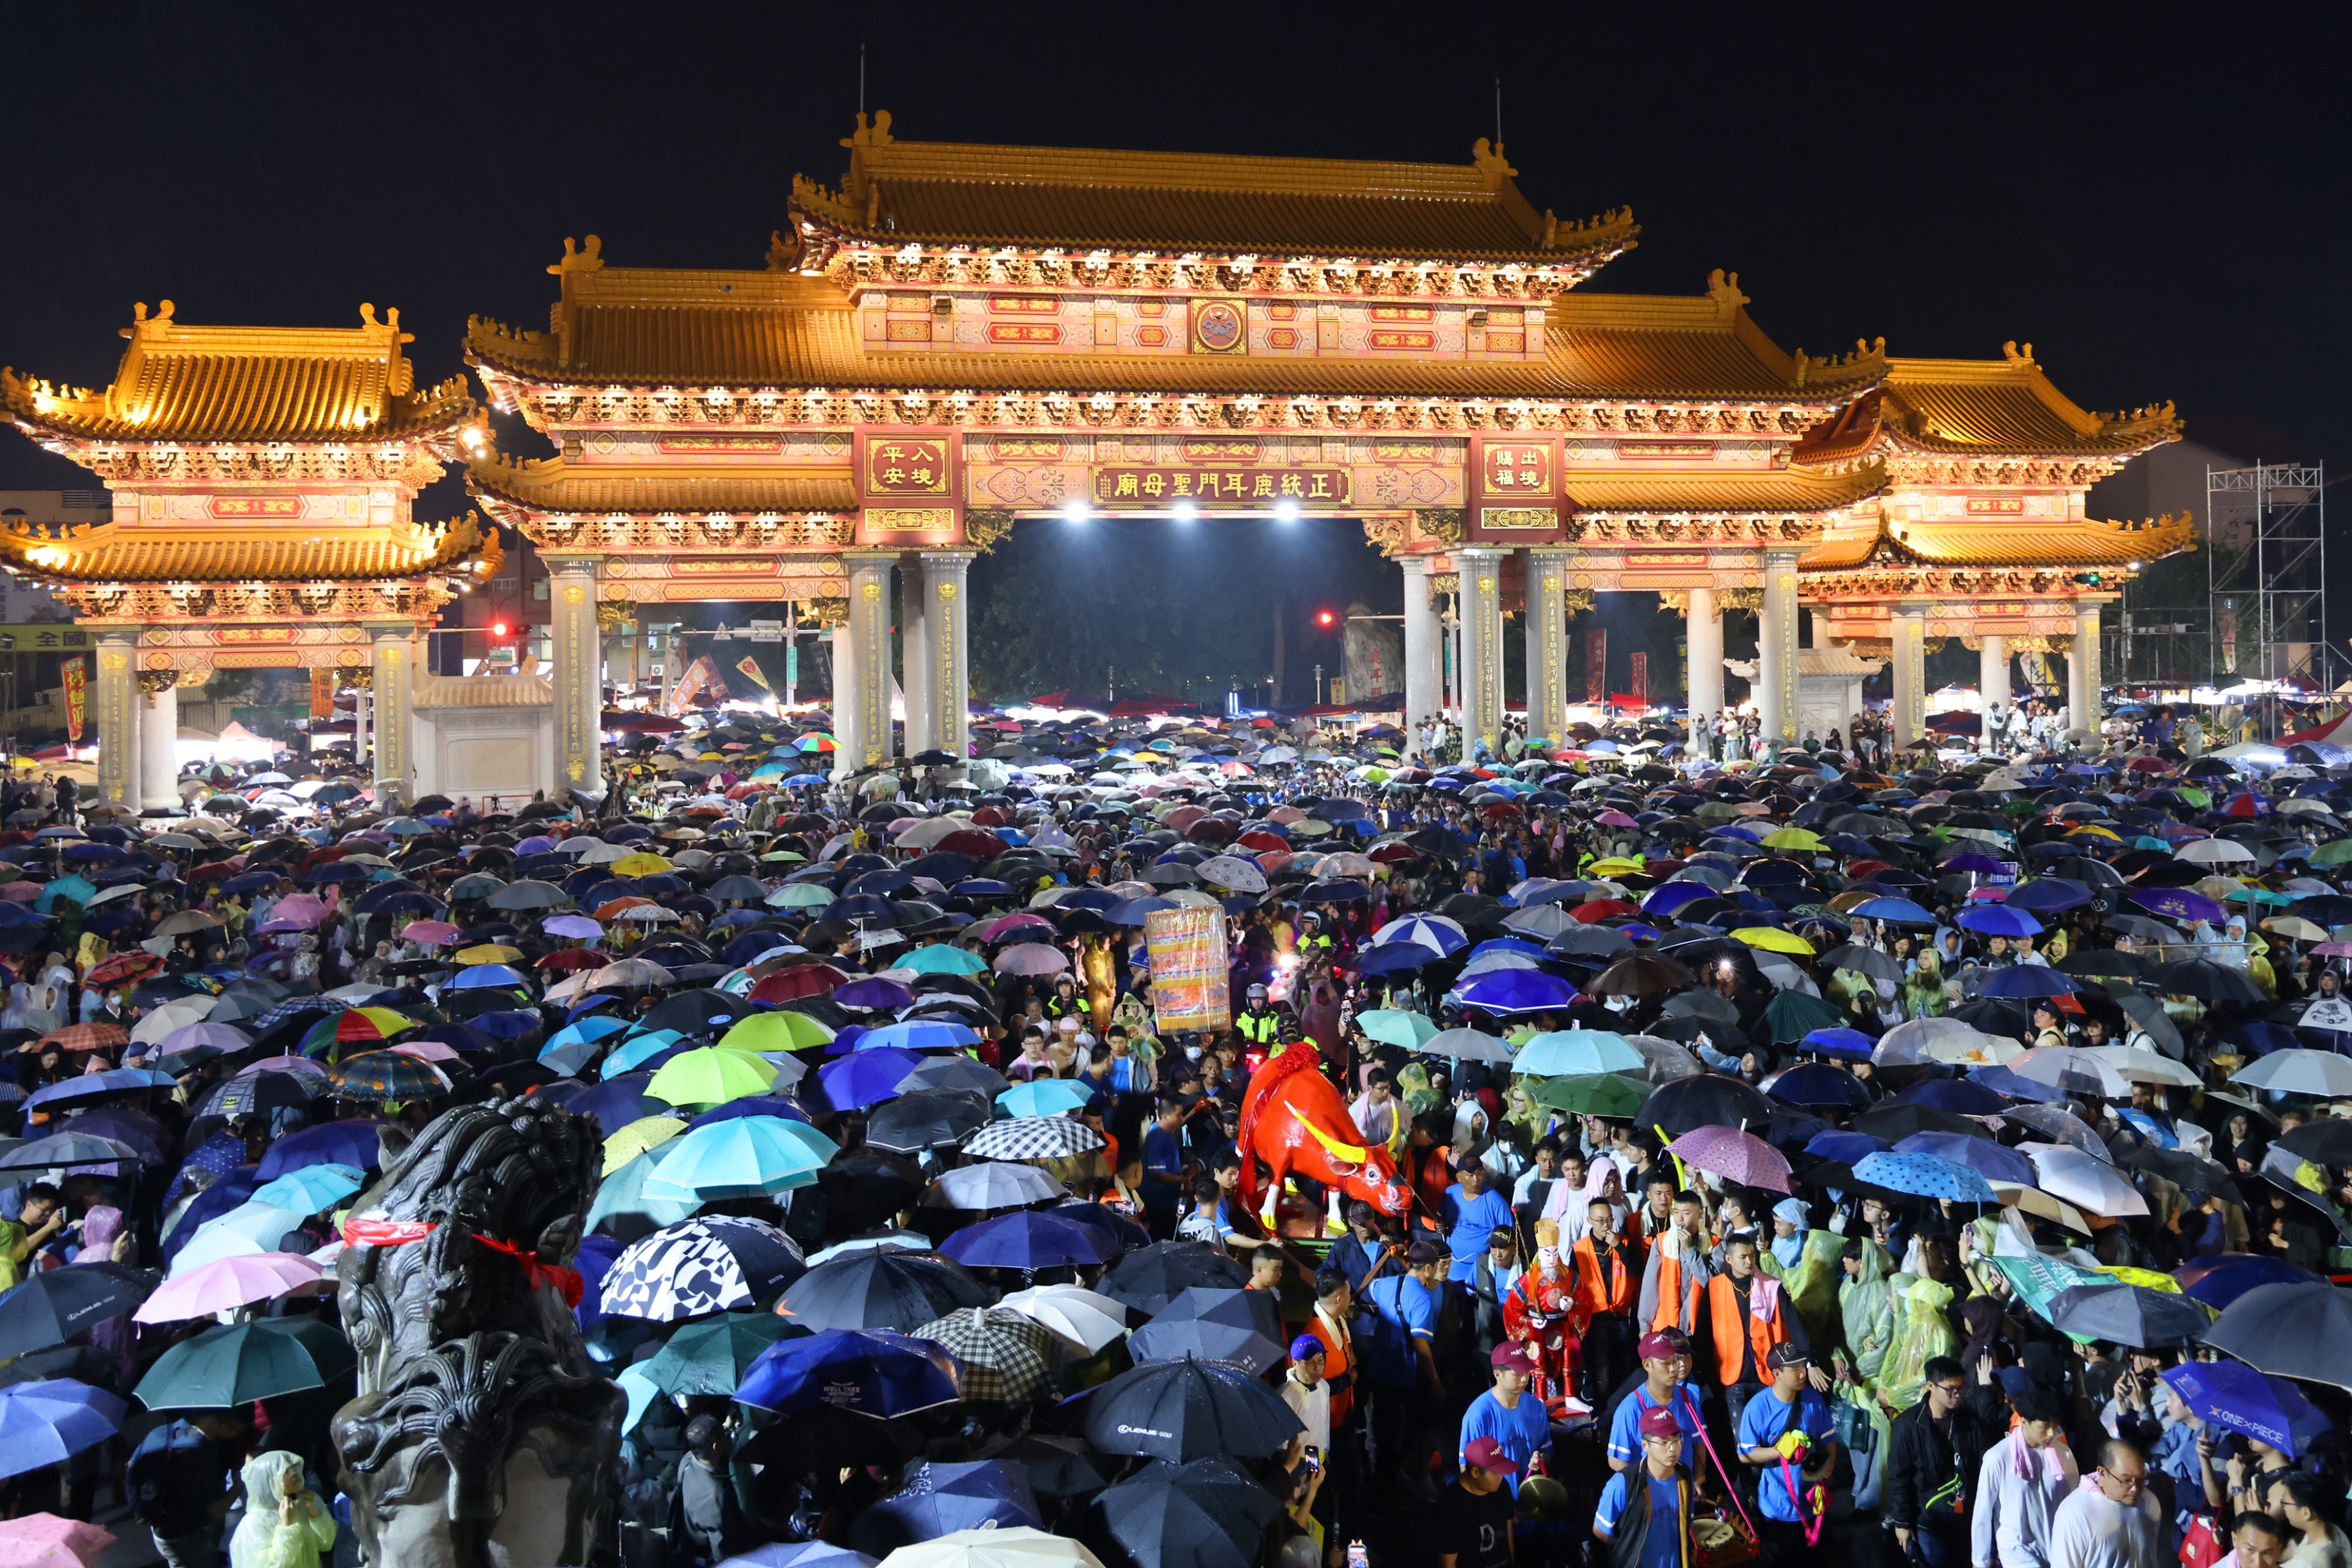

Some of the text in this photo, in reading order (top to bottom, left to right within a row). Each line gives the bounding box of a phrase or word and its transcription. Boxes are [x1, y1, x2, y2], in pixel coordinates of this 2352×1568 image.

[768, 1274, 785, 1285] TOYOTA
[75, 1301, 102, 1316] LEXUS
[1128, 1426, 1156, 1436] LEXUS
